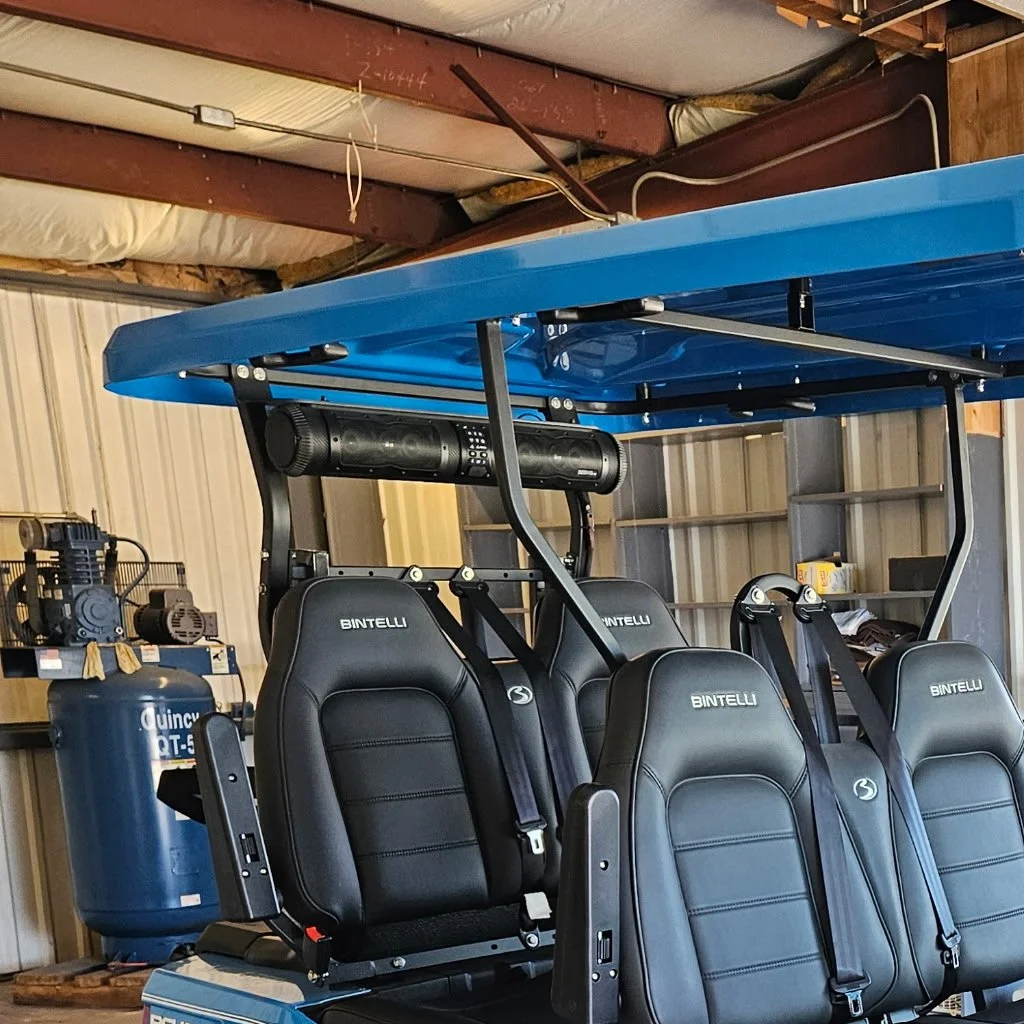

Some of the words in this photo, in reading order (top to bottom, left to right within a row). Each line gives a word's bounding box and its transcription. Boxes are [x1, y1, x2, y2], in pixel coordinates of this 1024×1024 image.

[340, 617, 407, 630] BINTELLI
[601, 615, 651, 627] INTELLI
[930, 679, 984, 697] BINTELLI
[690, 693, 758, 709] BINTELLI
